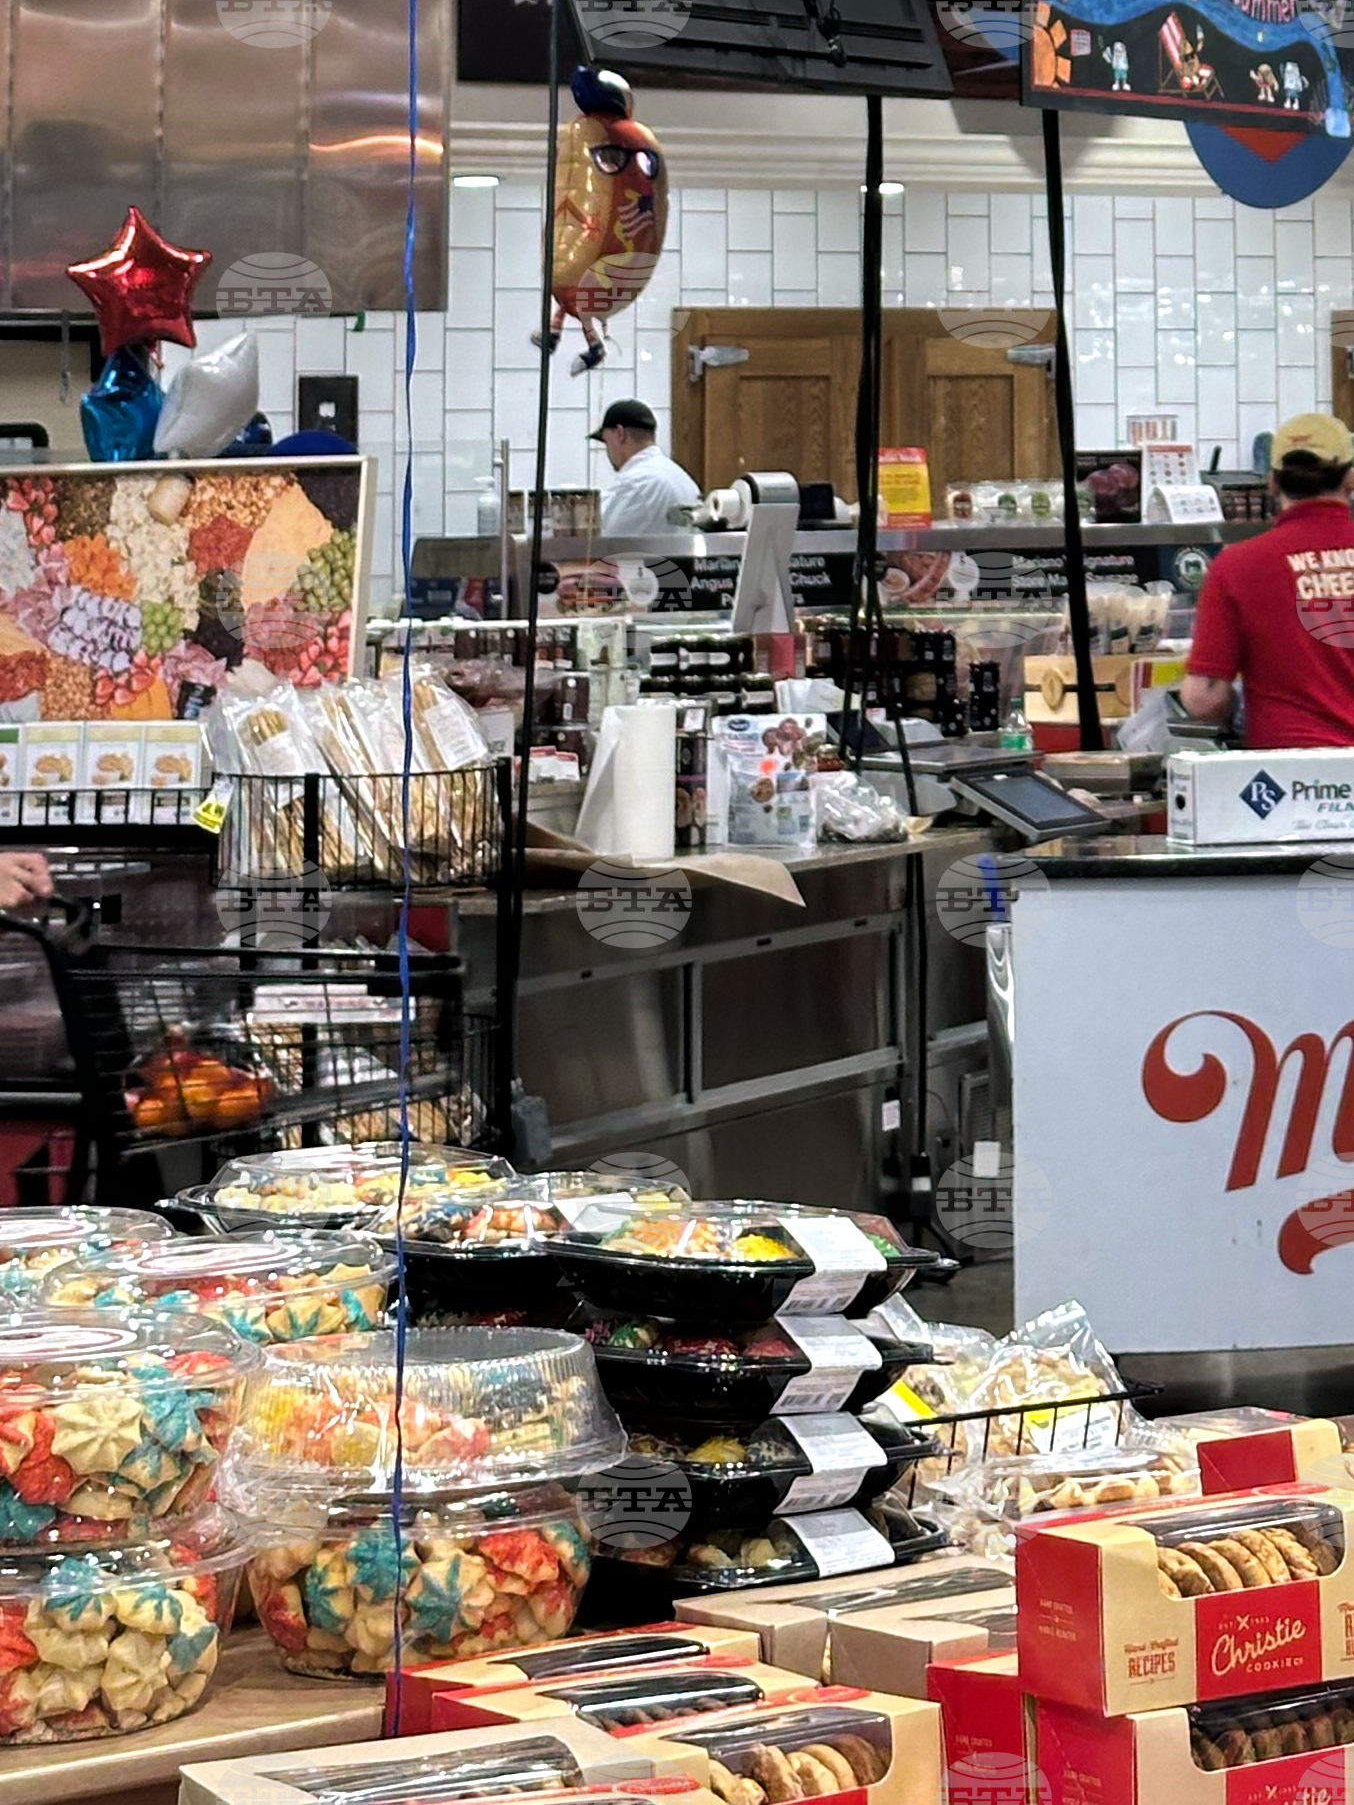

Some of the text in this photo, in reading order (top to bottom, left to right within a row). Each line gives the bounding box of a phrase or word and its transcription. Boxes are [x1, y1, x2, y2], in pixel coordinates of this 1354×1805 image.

[1286, 551, 1319, 572] WE
[1211, 1617, 1307, 1676] Christie
[1128, 1651, 1176, 1678] RECIPES
[1246, 1657, 1292, 1673] COOKIE
